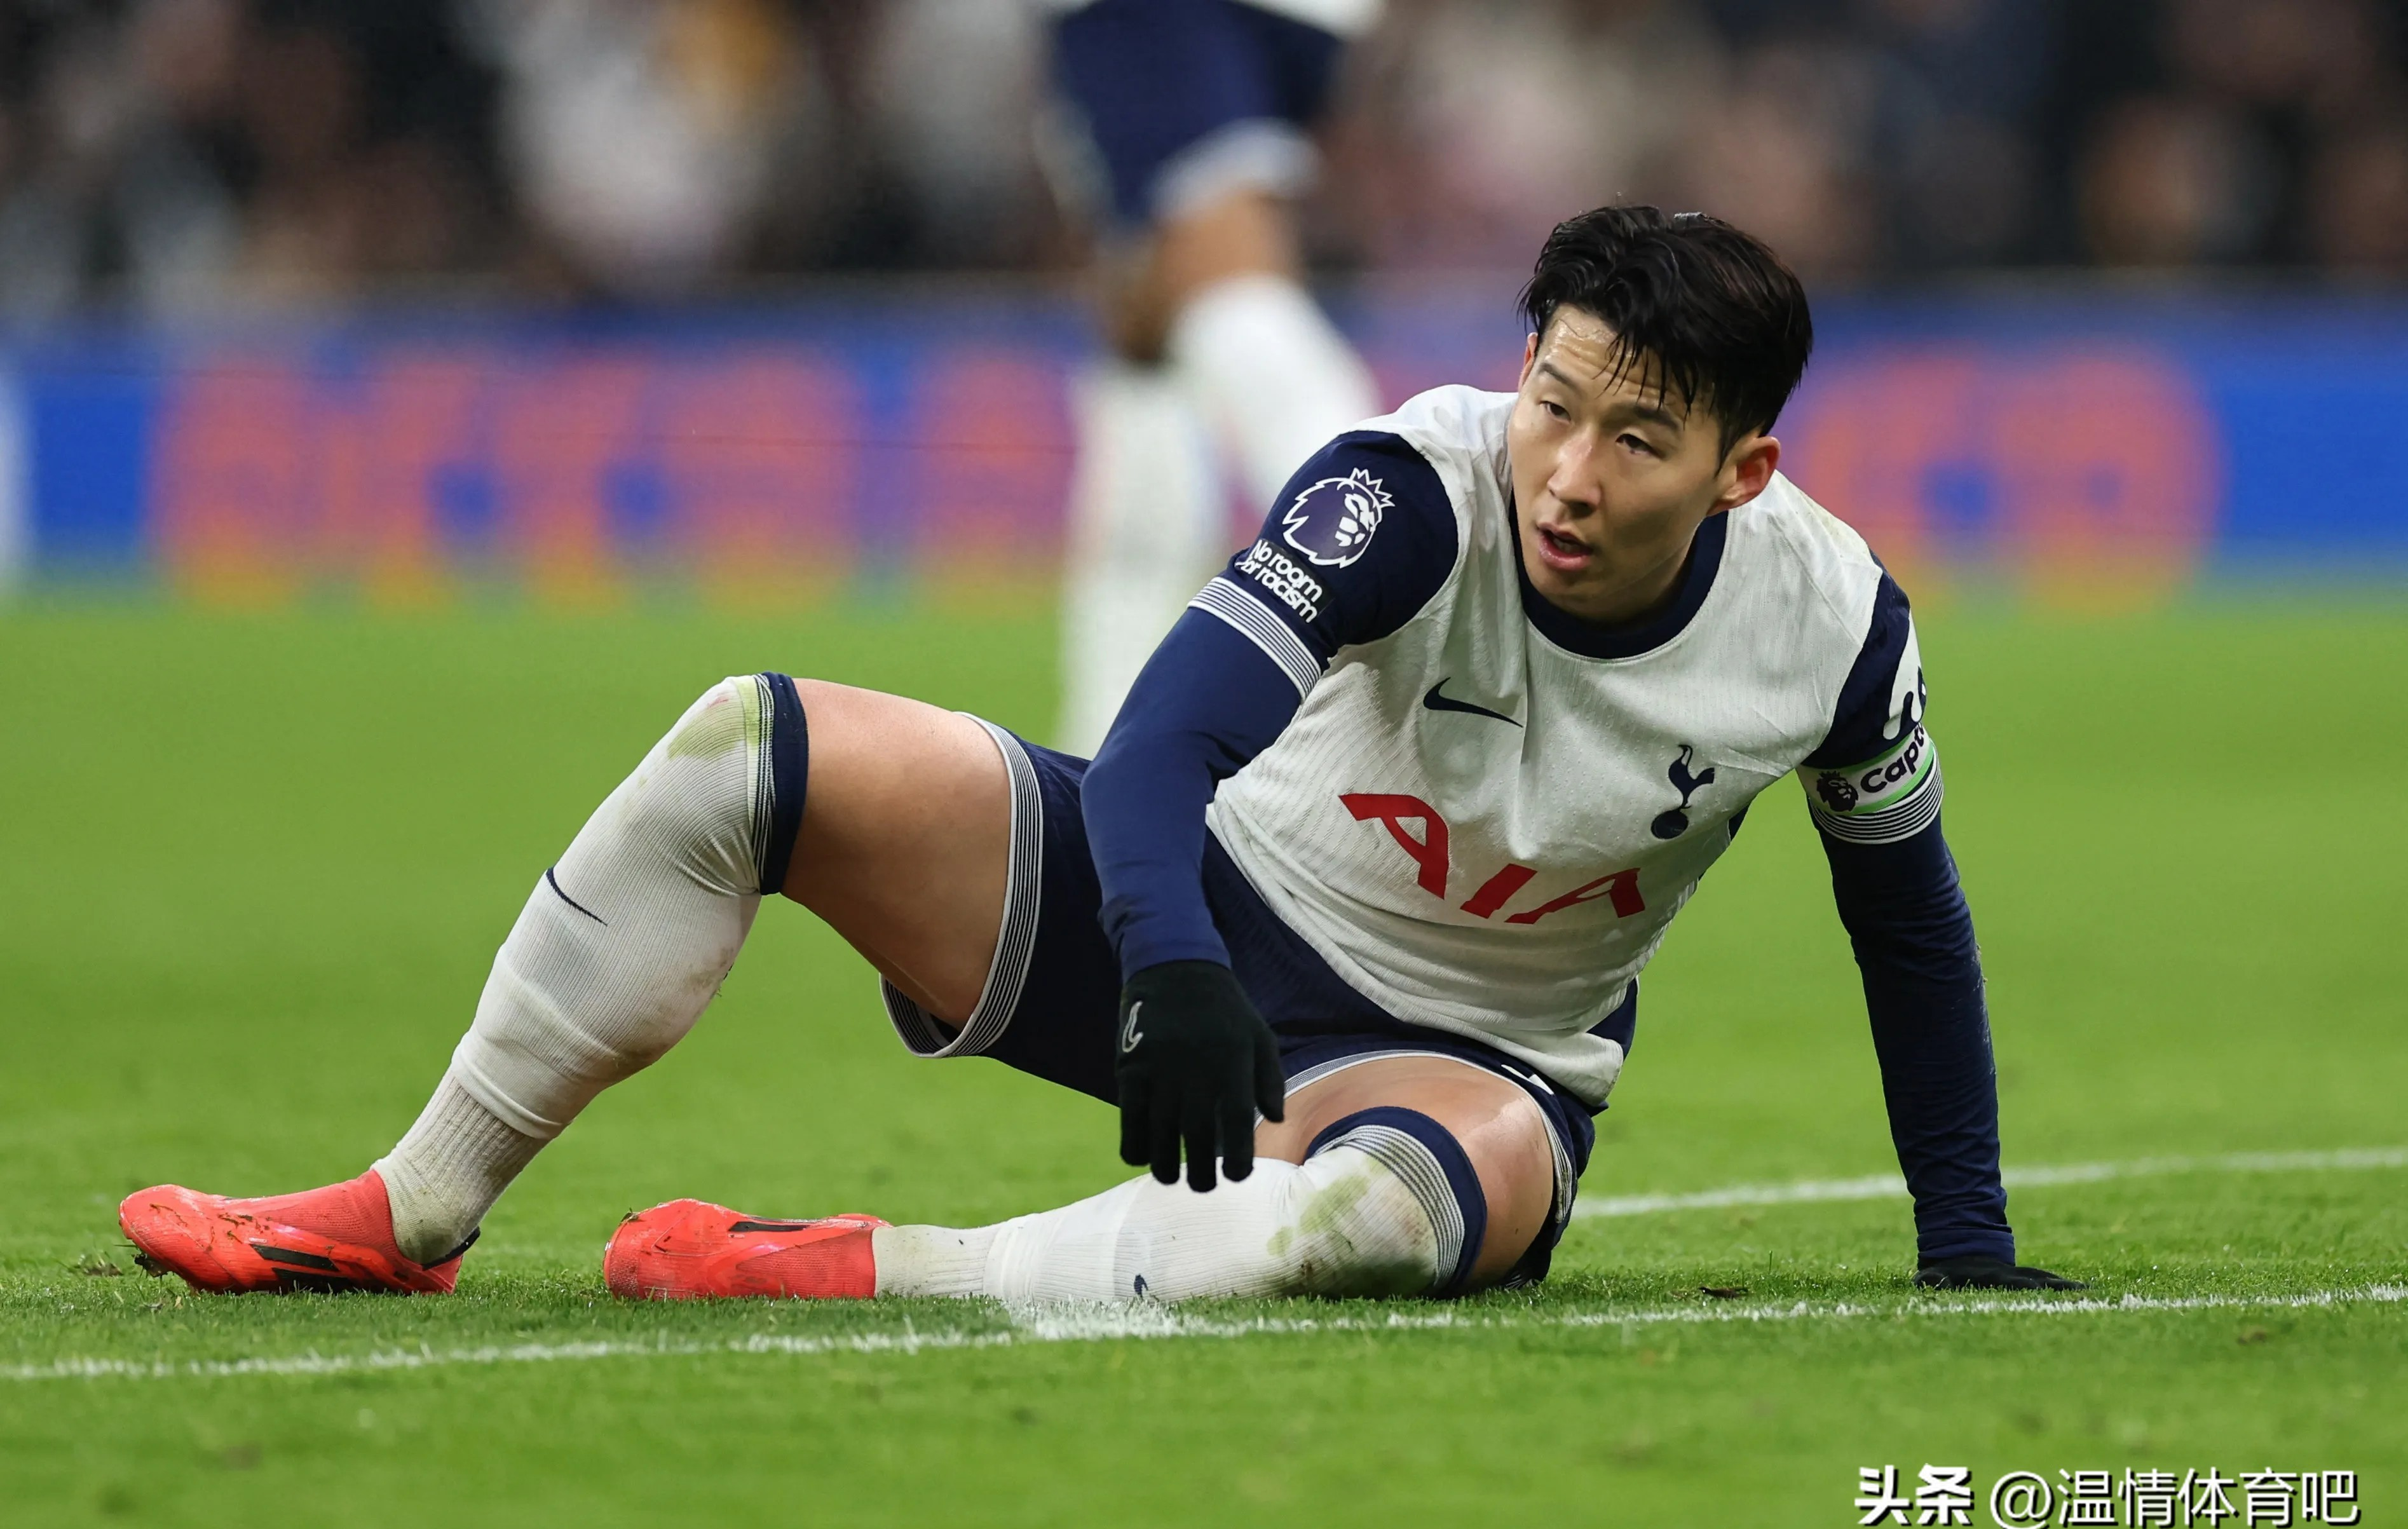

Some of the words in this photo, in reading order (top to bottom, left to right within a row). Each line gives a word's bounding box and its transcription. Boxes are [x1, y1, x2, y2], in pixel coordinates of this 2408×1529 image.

[1245, 539, 1272, 562] No
[1268, 552, 1323, 603] room
[1255, 566, 1318, 623] racism
[1338, 792, 1645, 925] AIA
